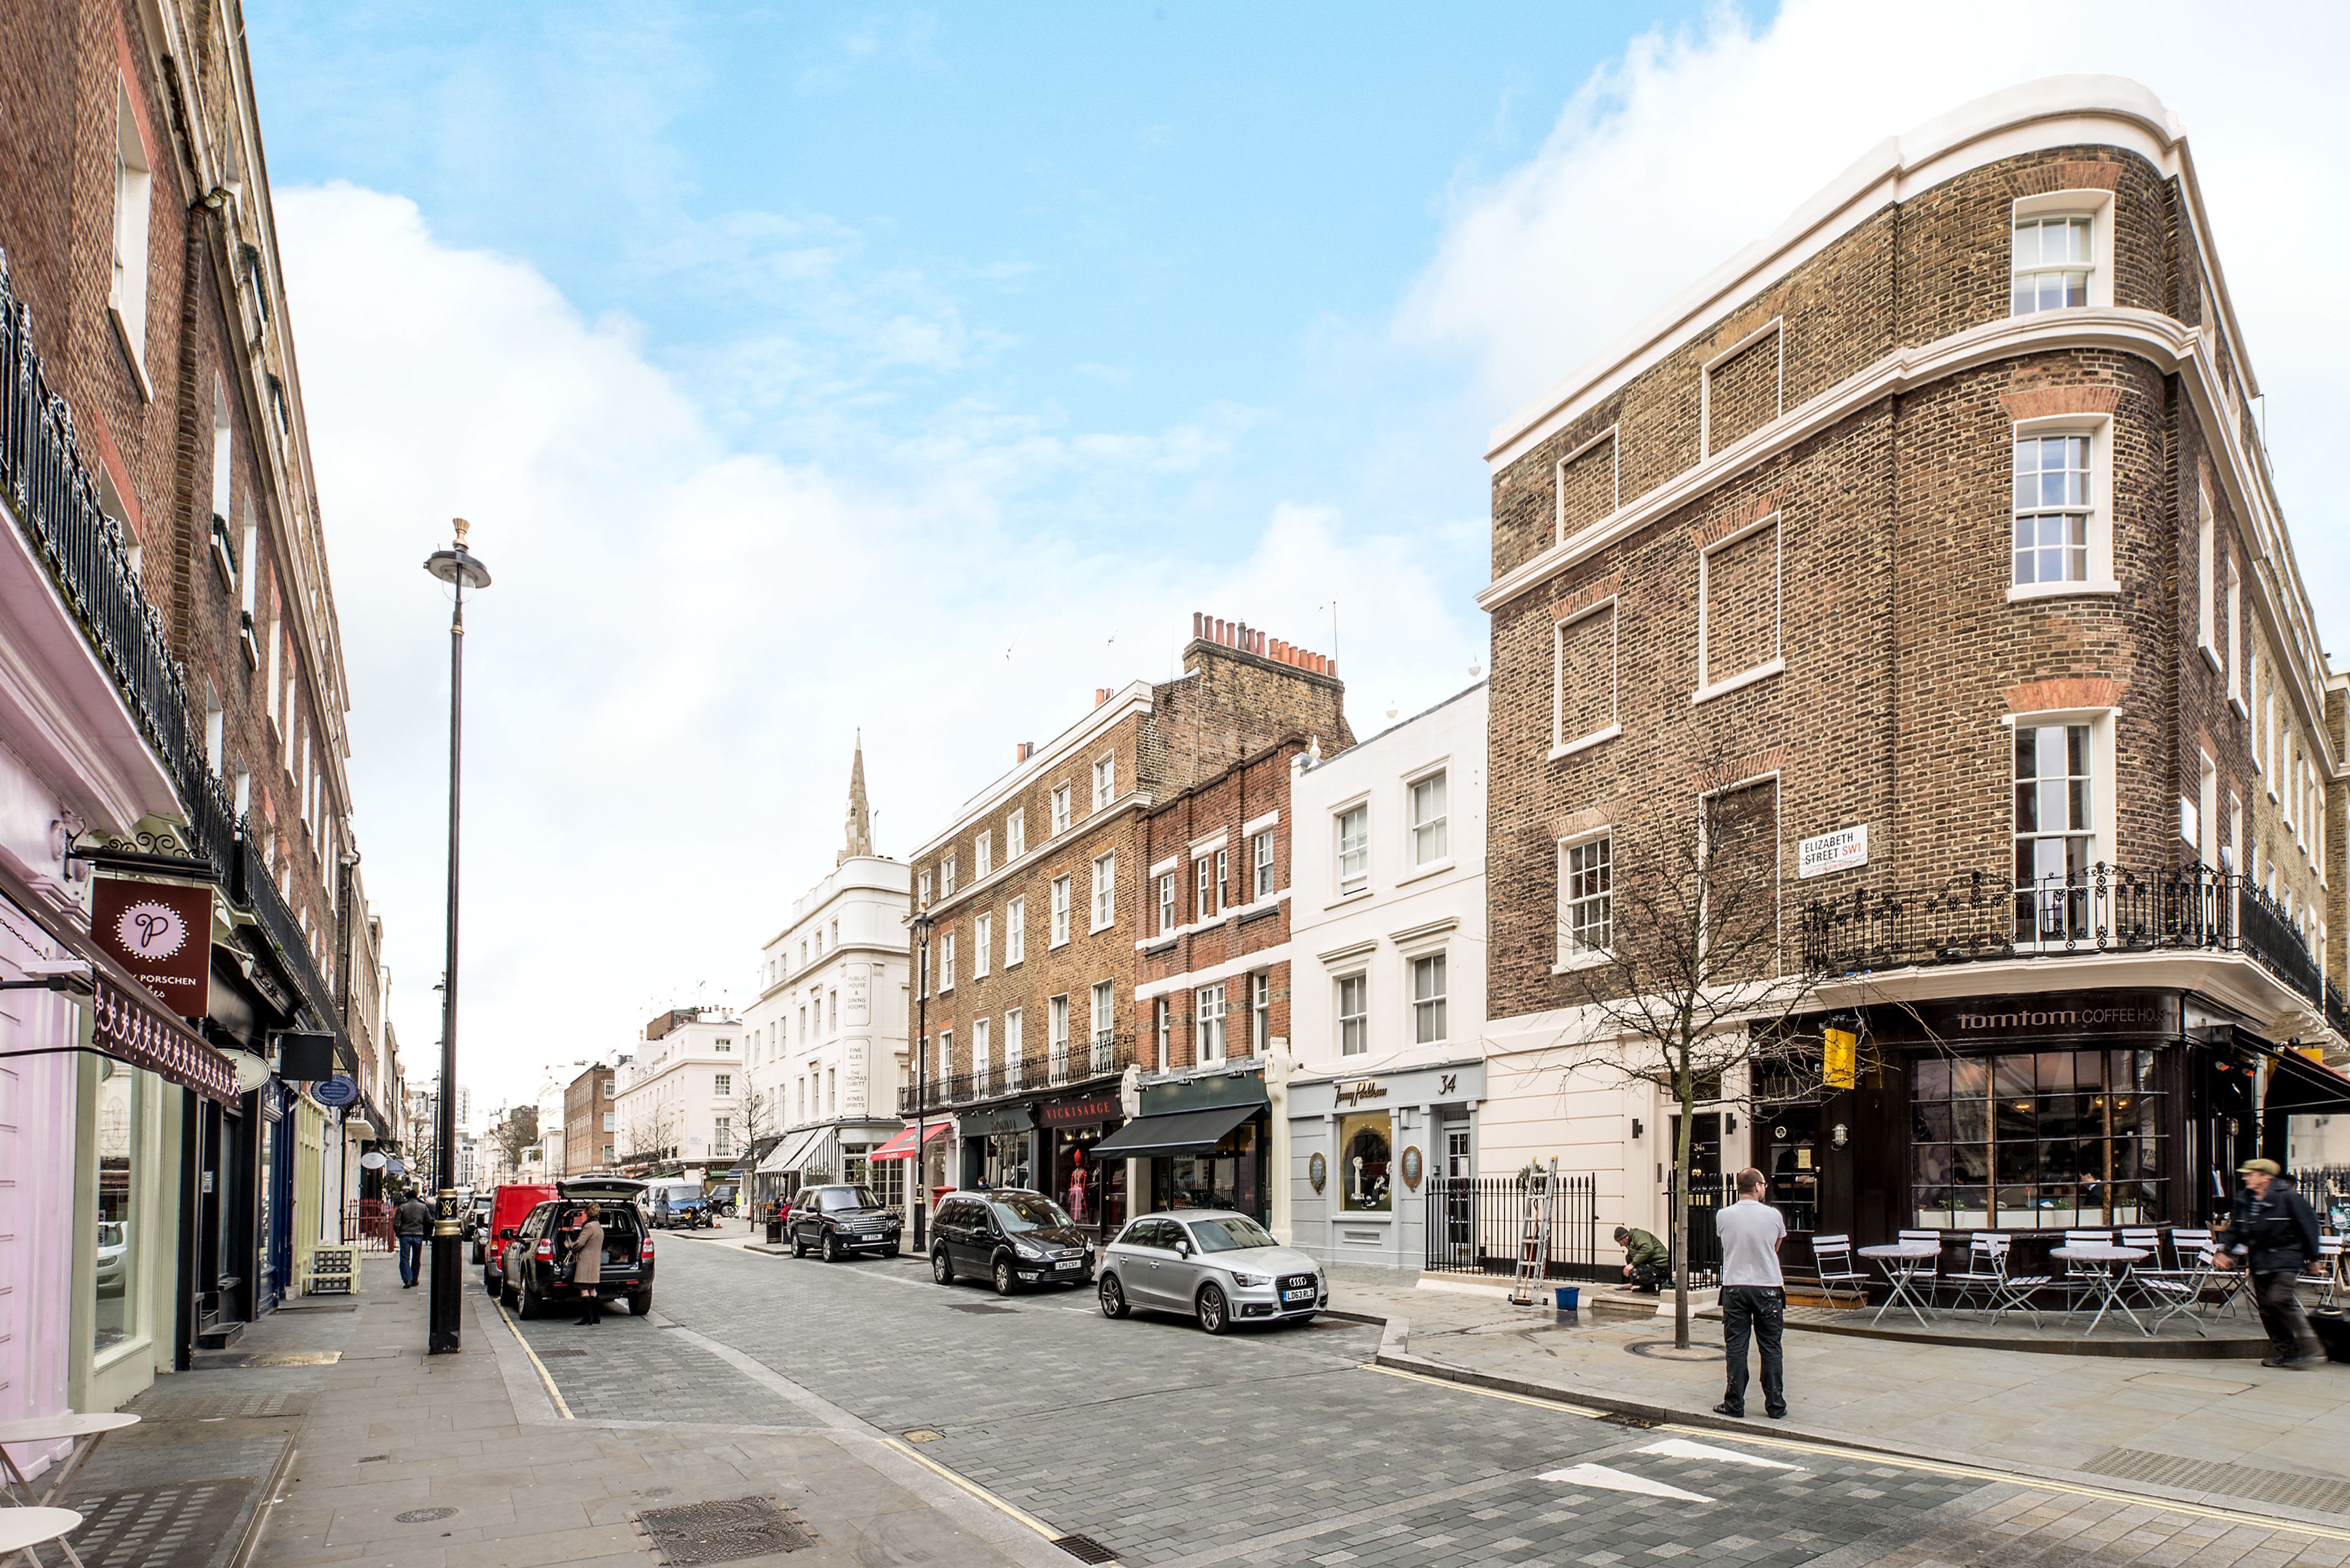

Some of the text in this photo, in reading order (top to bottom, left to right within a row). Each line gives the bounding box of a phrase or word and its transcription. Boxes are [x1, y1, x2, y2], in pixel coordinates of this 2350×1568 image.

[1806, 832, 1853, 852] ELIZABETH
[1806, 843, 1861, 865] STREET SW1
[140, 974, 196, 986] PORSCHEN
[1958, 1008, 2166, 1029] tomtom COFFEE HOUS
[1438, 1074, 1457, 1095] 34
[1046, 1102, 1110, 1119] VICKISARGE
[1303, 1289, 1313, 1297] RLZ
